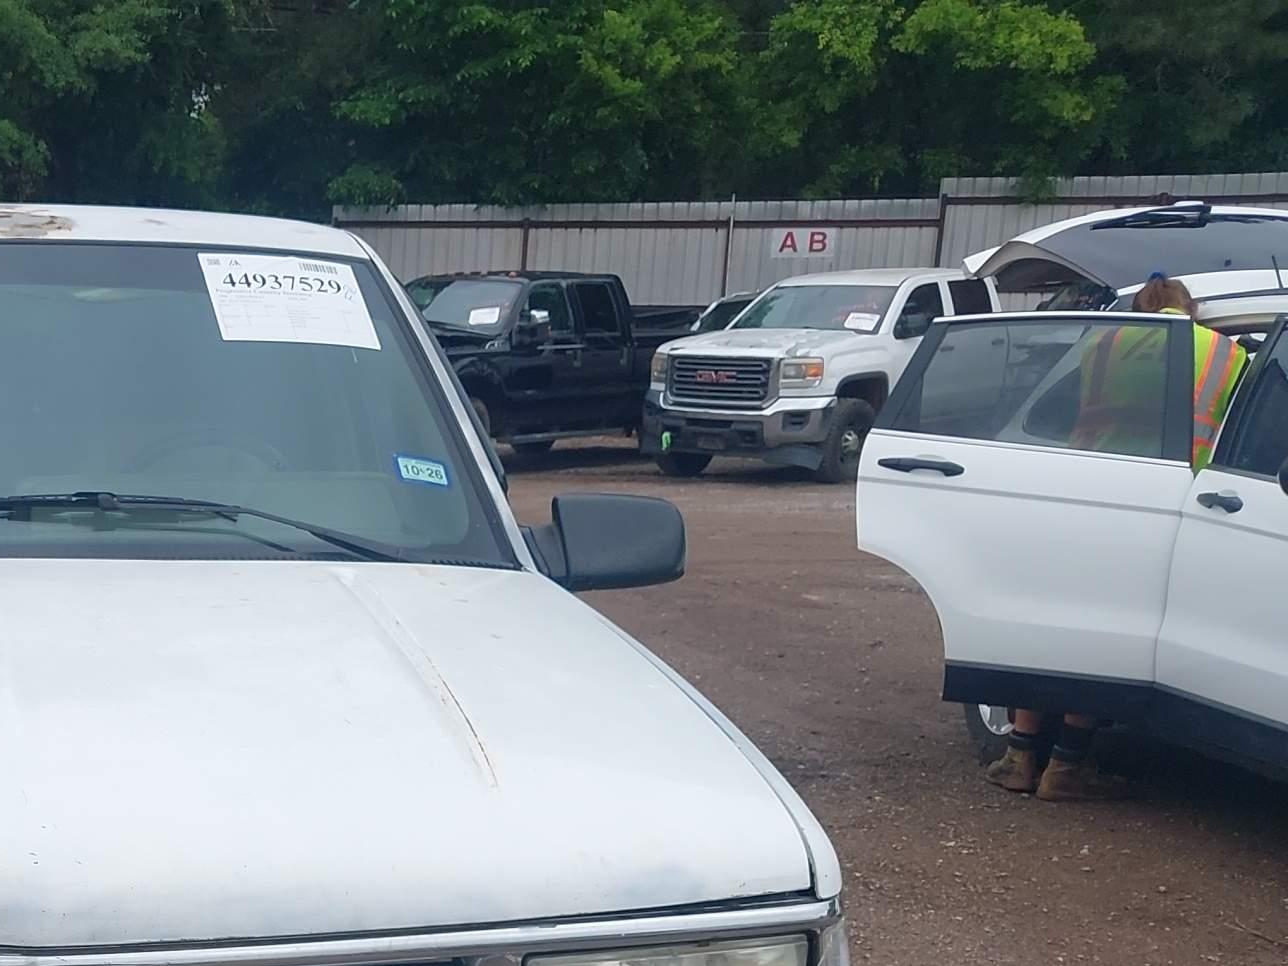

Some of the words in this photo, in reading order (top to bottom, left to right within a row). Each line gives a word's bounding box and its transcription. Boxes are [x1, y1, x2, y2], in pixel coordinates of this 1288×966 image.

[778, 231, 798, 253] A
[808, 231, 828, 253] B
[222, 271, 342, 294] 44937529
[695, 369, 737, 384] GMC
